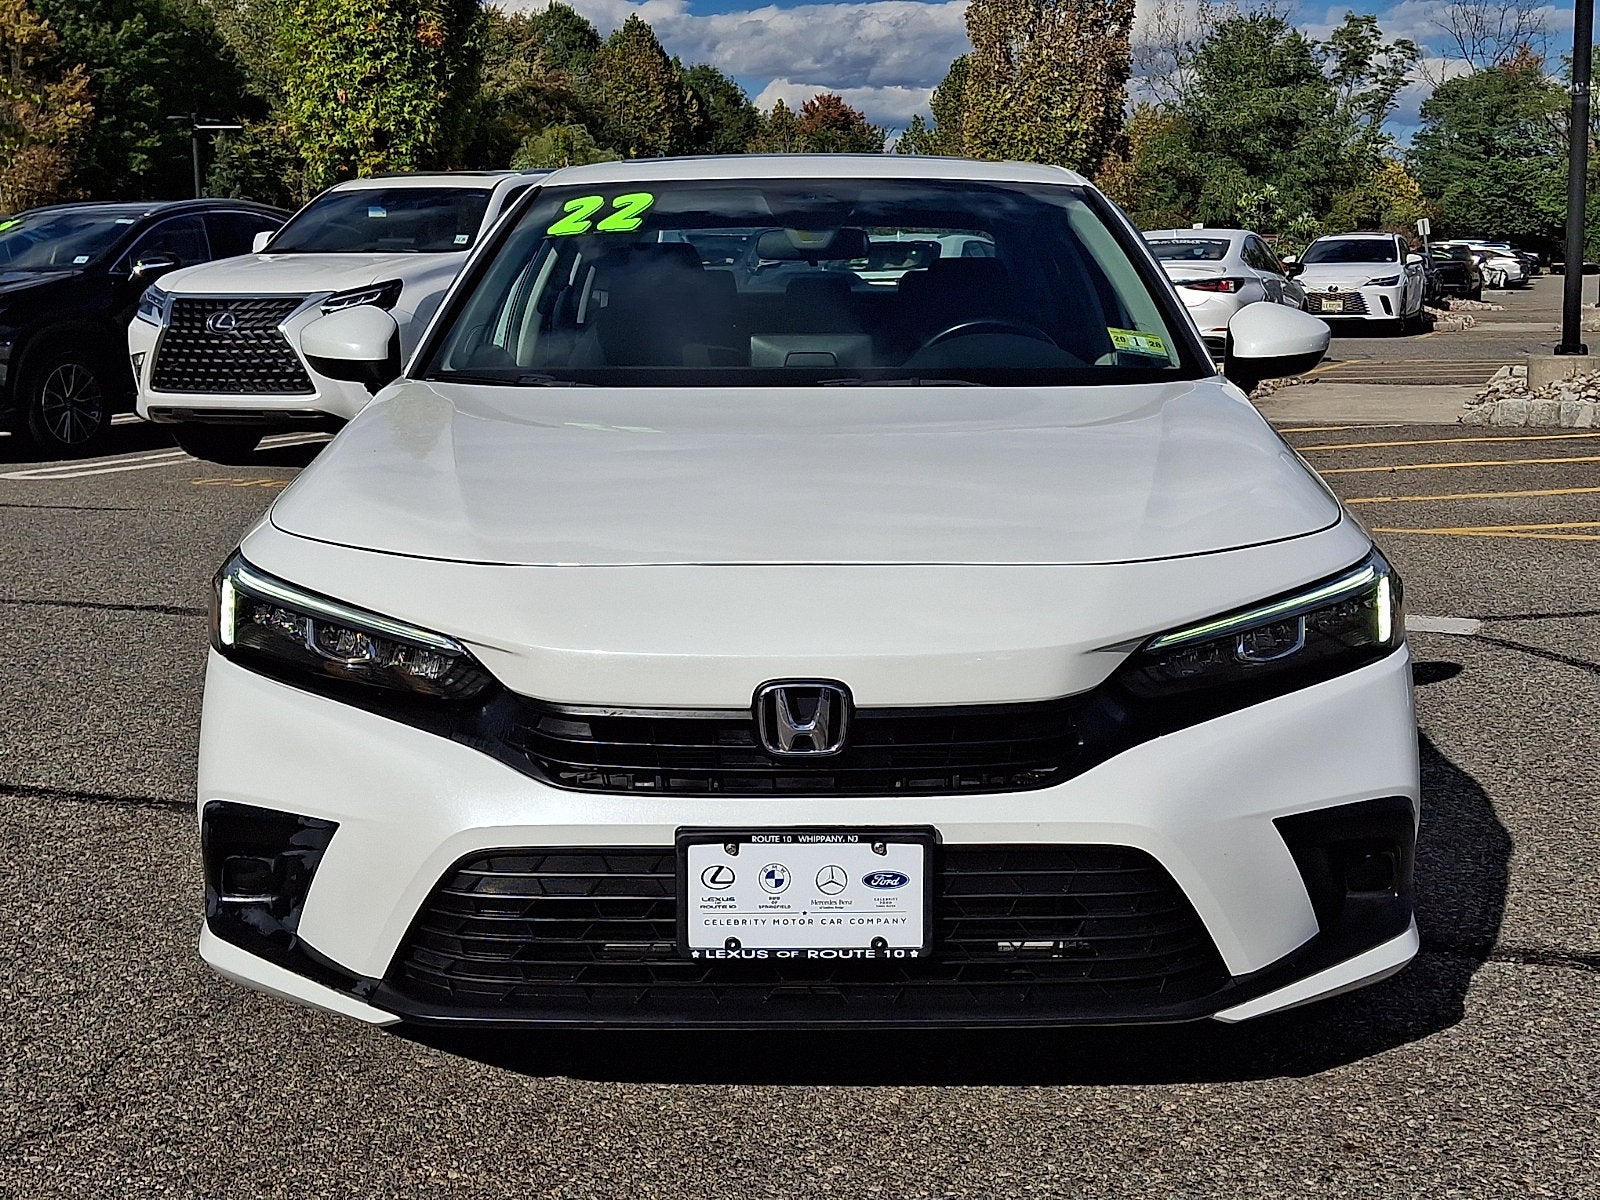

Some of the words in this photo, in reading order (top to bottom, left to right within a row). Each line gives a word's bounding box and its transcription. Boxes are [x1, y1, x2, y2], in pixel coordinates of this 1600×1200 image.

[546, 191, 655, 237] 22
[751, 835, 780, 843] ROUTE
[782, 835, 792, 843] 10
[847, 835, 859, 843] NJ
[871, 874, 900, 886] Ford
[703, 918, 767, 926] CELEBRITY
[772, 918, 815, 926] MOTOR
[820, 918, 843, 926] CAR
[849, 917, 908, 925] COMPANY
[705, 949, 769, 959] LEXUS
[776, 950, 800, 958] OF
[807, 949, 876, 959] ROUTE
[883, 949, 906, 959] 10
